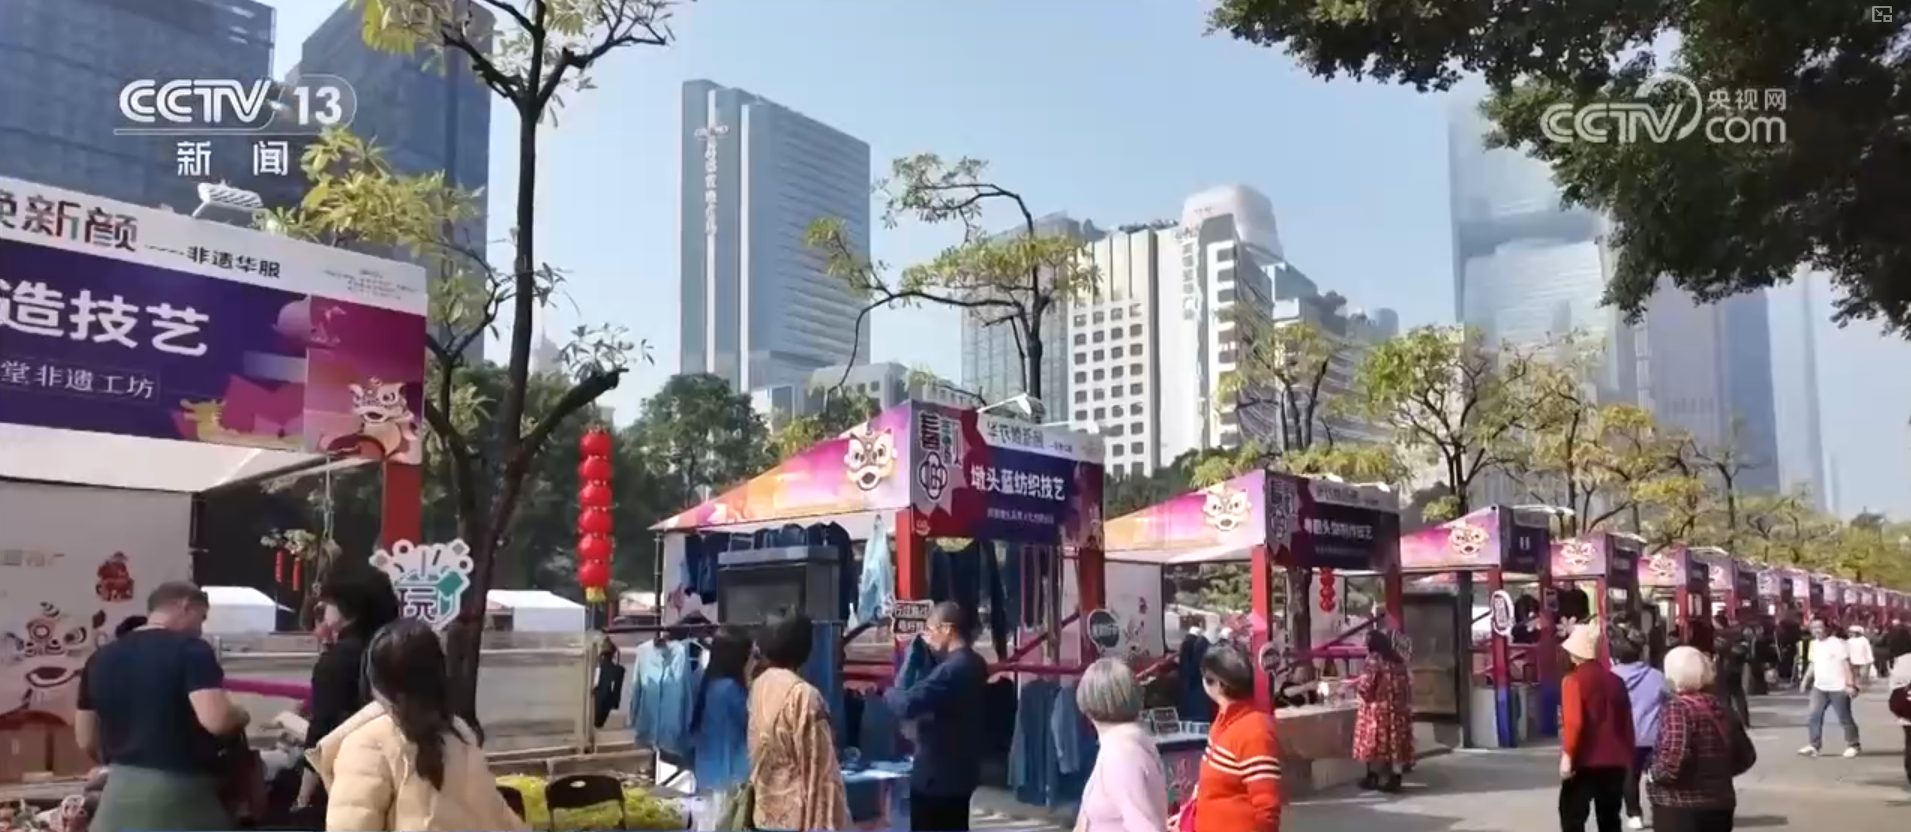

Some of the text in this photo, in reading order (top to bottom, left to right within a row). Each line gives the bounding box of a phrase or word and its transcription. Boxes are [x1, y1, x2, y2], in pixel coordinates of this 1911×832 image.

[0, 279, 209, 357] 造技艺
[1, 360, 155, 399] 堂非遗工坊
